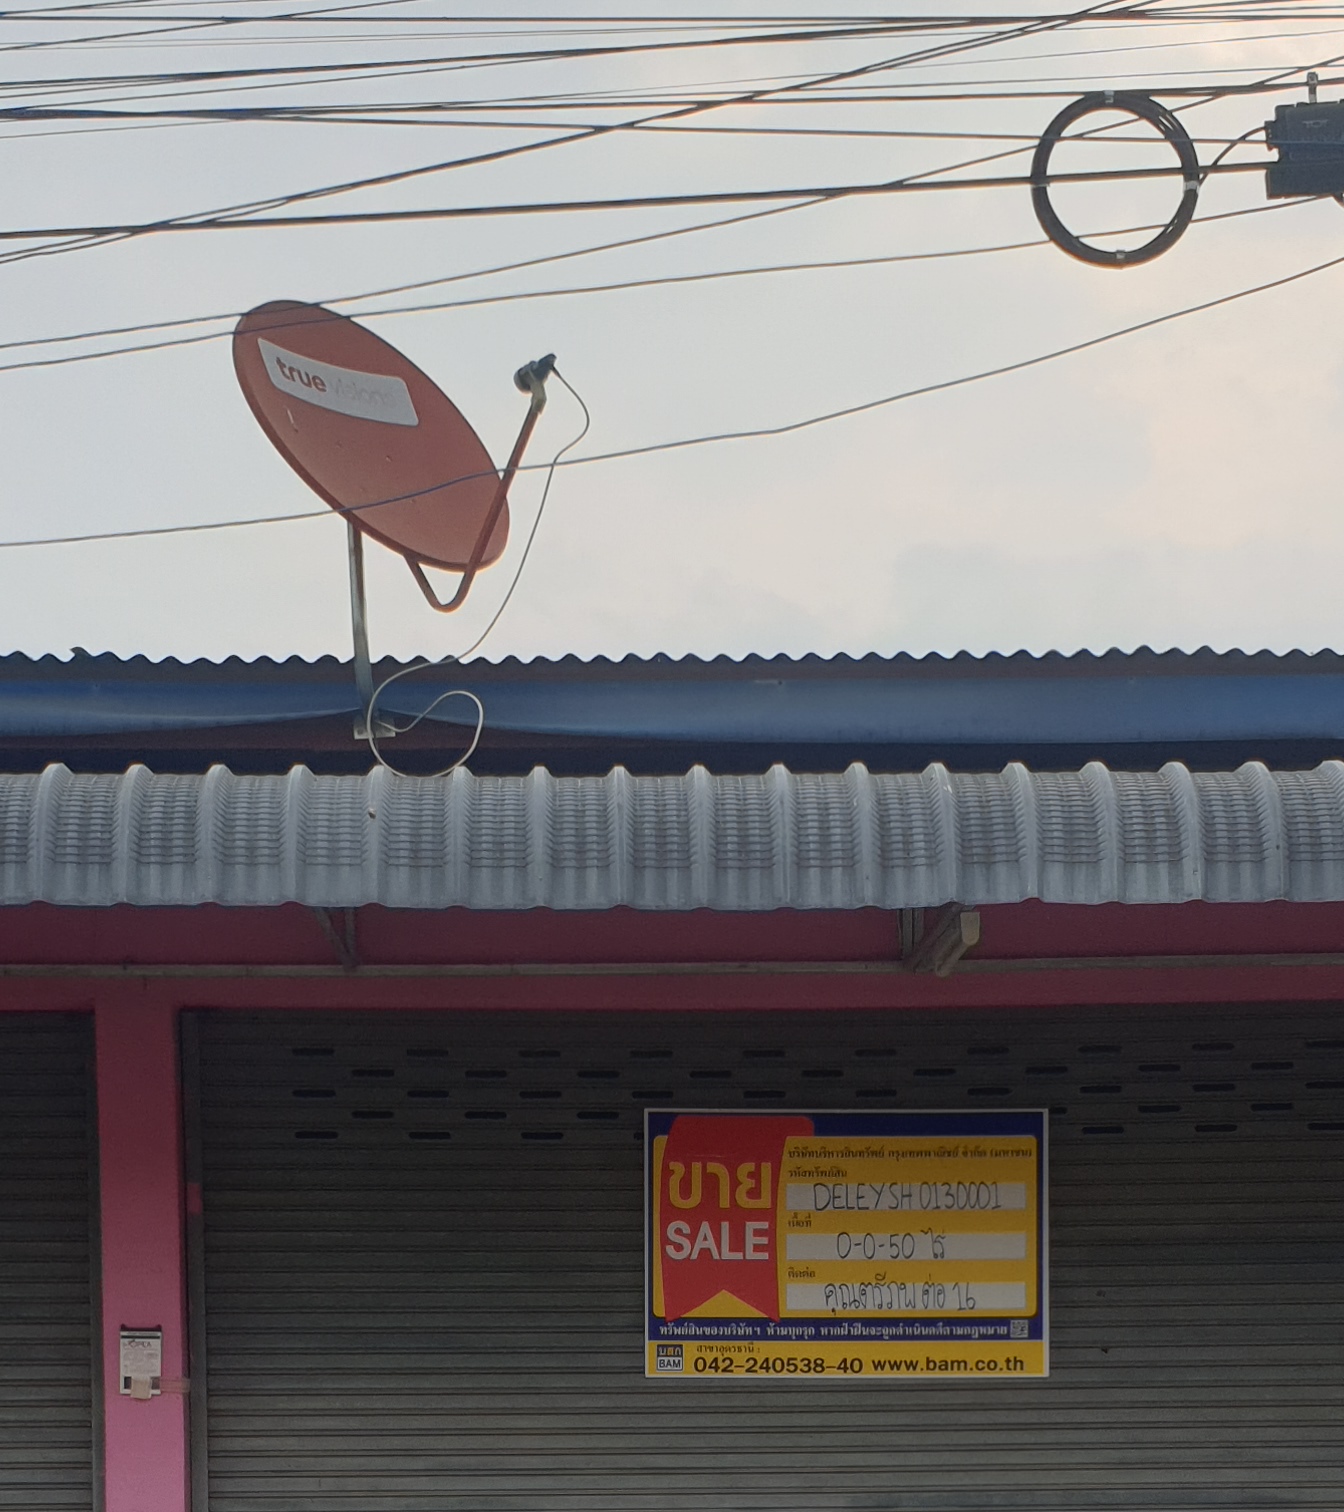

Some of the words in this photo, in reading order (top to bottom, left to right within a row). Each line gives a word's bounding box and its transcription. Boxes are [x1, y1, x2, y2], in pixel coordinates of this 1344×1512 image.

[275, 356, 327, 393] true
[668, 1161, 772, 1209] ขาย
[665, 1221, 769, 1260] SALE
[835, 1231, 916, 1260] 0-0-50
[658, 1358, 682, 1369] BAM
[693, 1356, 863, 1374] 042-240538-40
[871, 1356, 1024, 1372] www.bam.co.th
